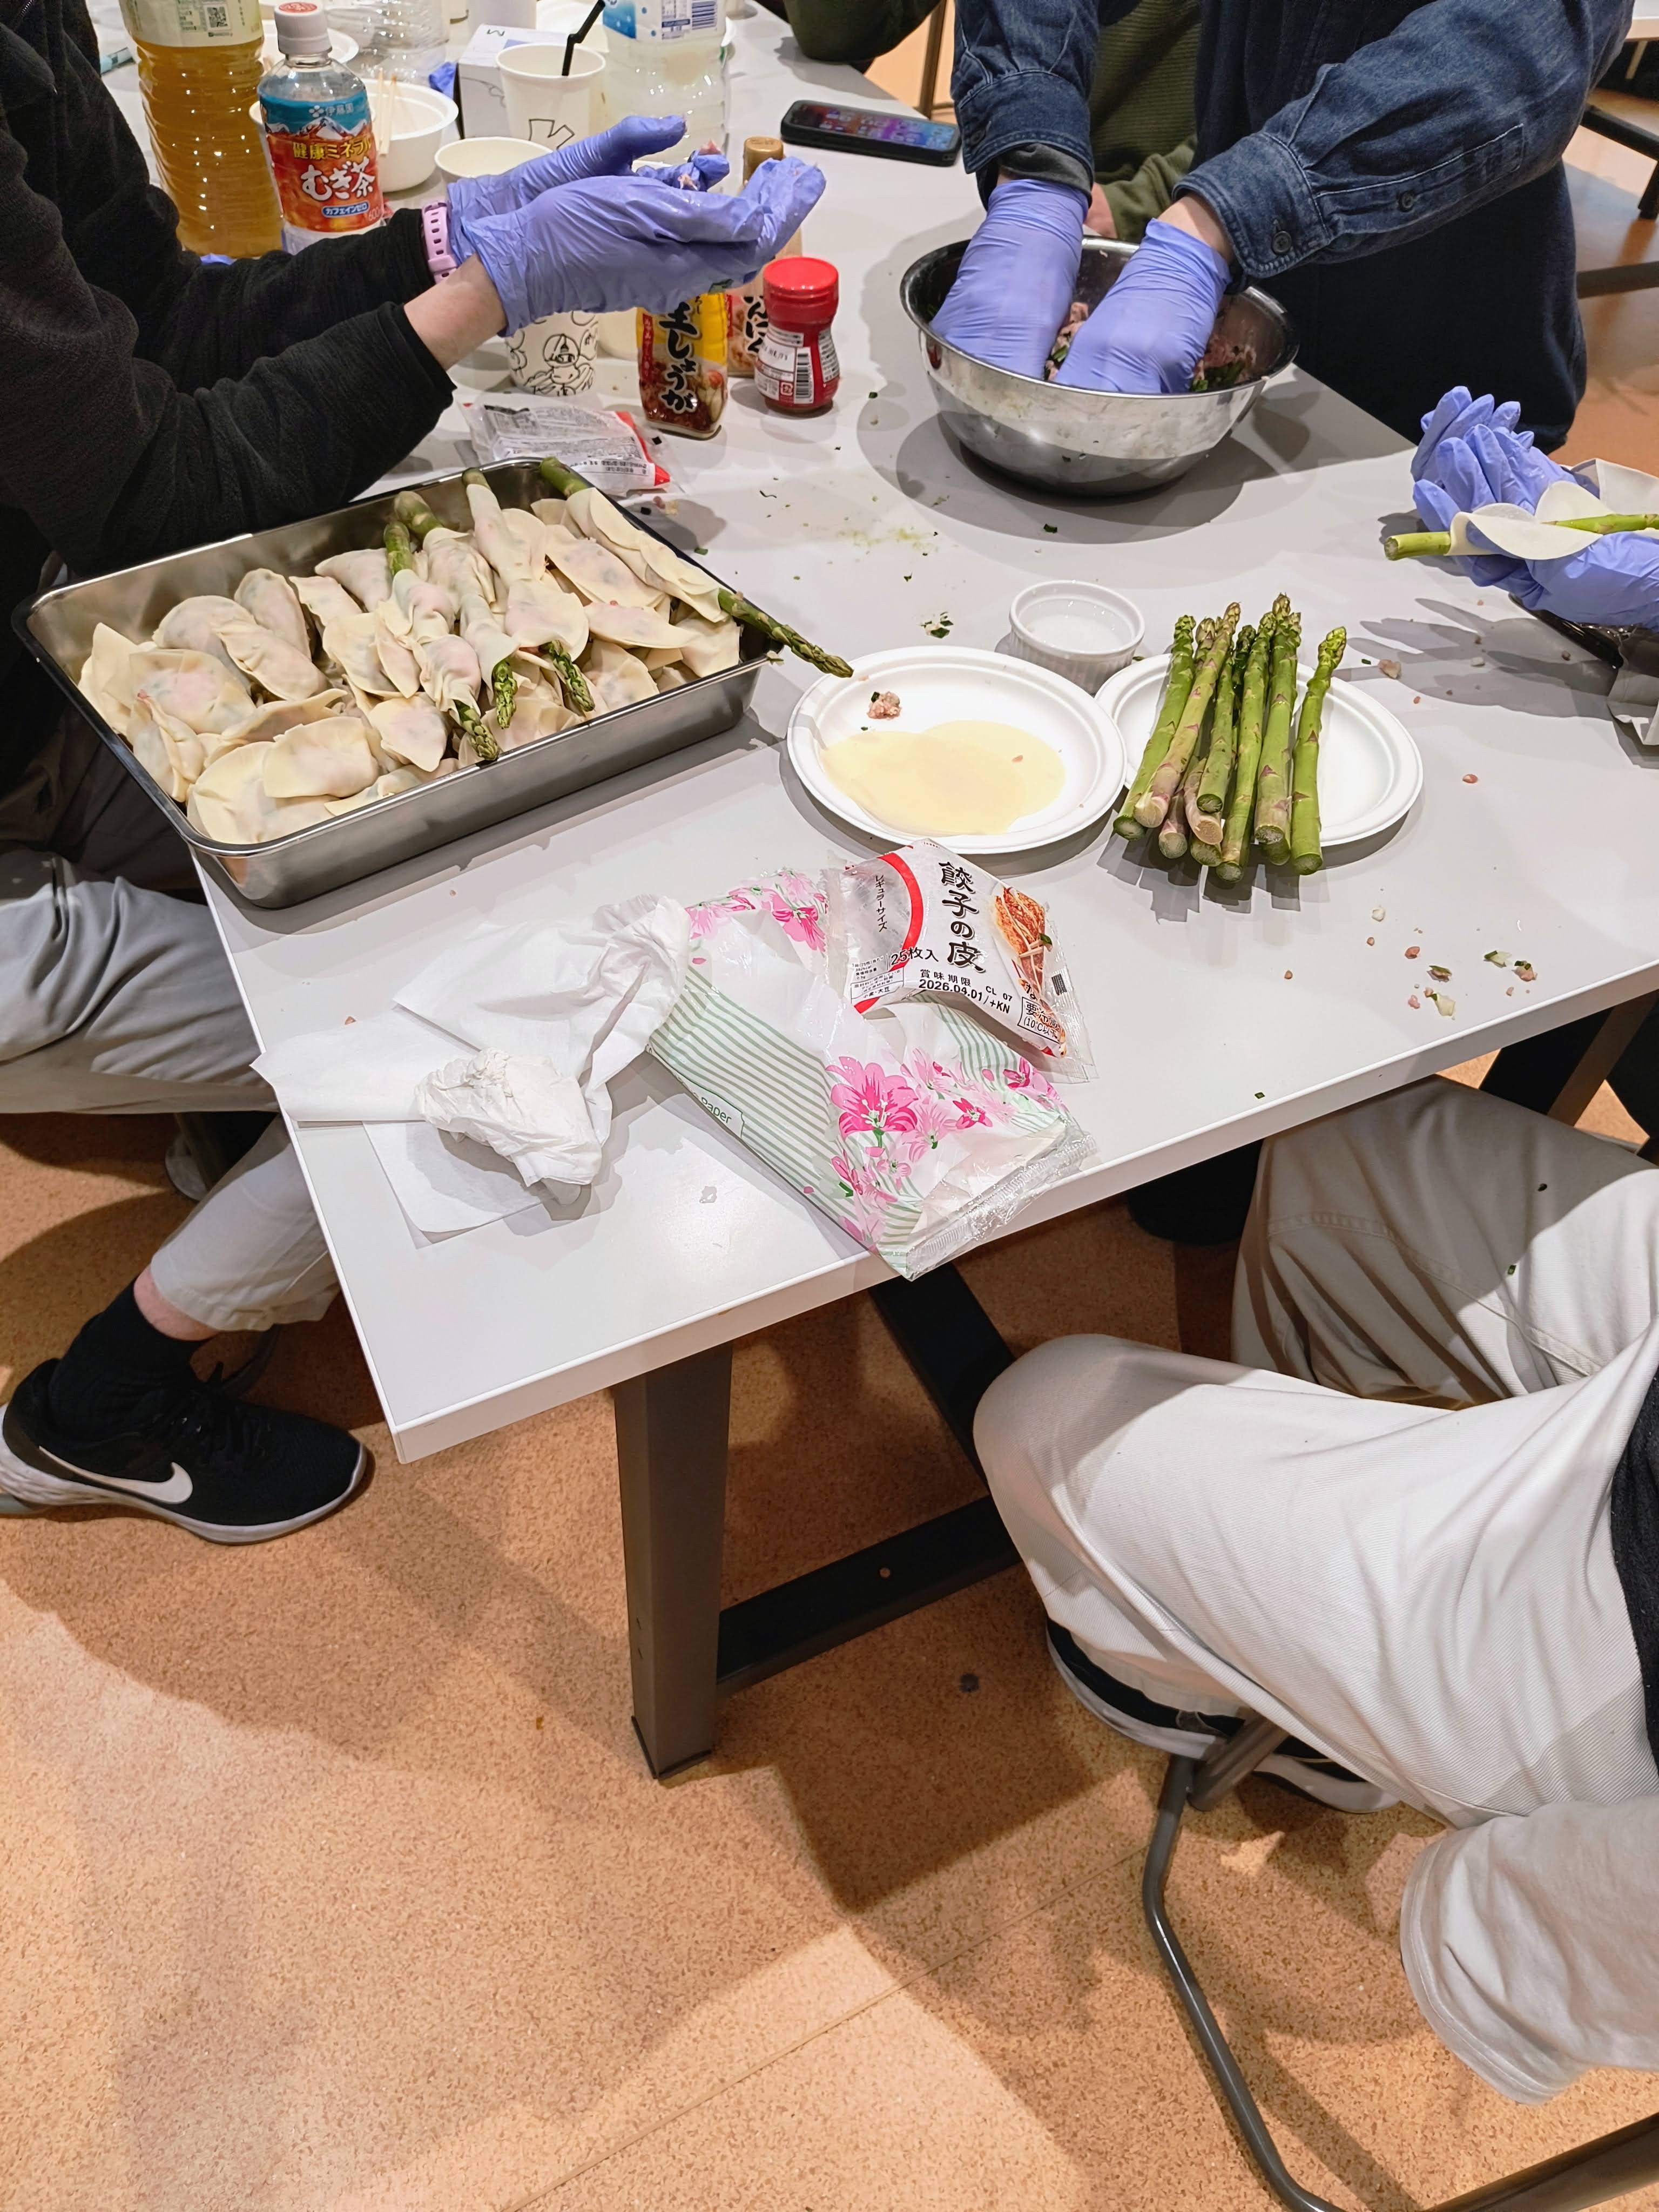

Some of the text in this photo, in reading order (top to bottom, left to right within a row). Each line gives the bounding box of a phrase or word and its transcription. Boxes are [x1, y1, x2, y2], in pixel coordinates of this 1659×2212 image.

[293, 136, 372, 159] 健康ミネラル
[301, 156, 375, 201] むぎ茶
[326, 202, 368, 215] カフェインゼロ
[744, 296, 768, 354] んにく
[875, 874, 887, 932] レギュラーサイズ
[938, 861, 986, 972] 餃子の皮
[891, 947, 939, 966] 25枚入
[920, 969, 971, 987] 賞味期限
[986, 986, 1013, 1002] CL 07
